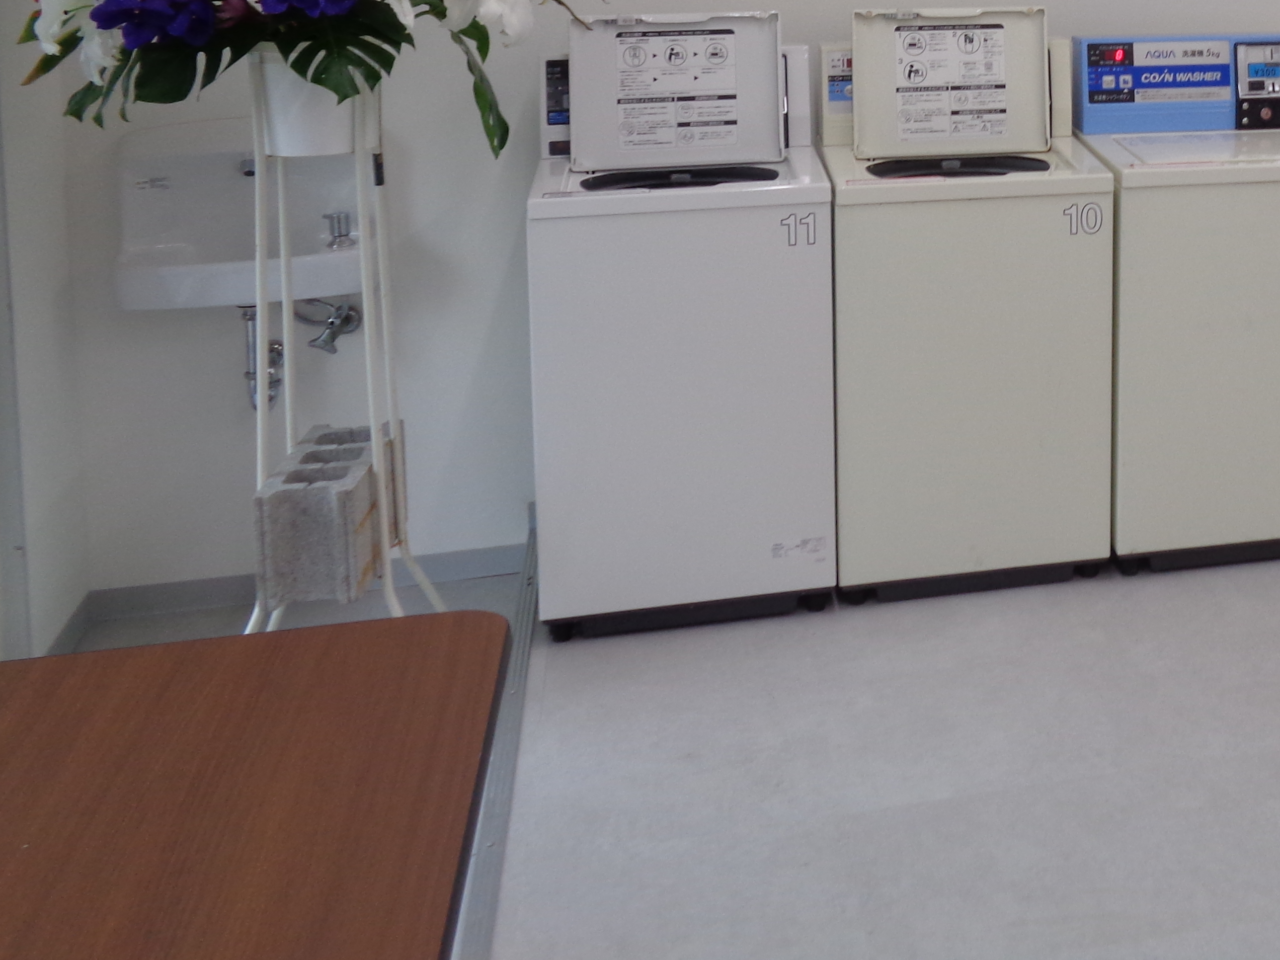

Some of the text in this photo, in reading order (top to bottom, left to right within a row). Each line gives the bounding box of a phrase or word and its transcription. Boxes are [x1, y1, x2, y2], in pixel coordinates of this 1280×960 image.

[1145, 50, 1176, 59] AQUA
[1175, 71, 1221, 82] WASHER
[780, 212, 817, 246] 11
[1062, 202, 1104, 236] 10
